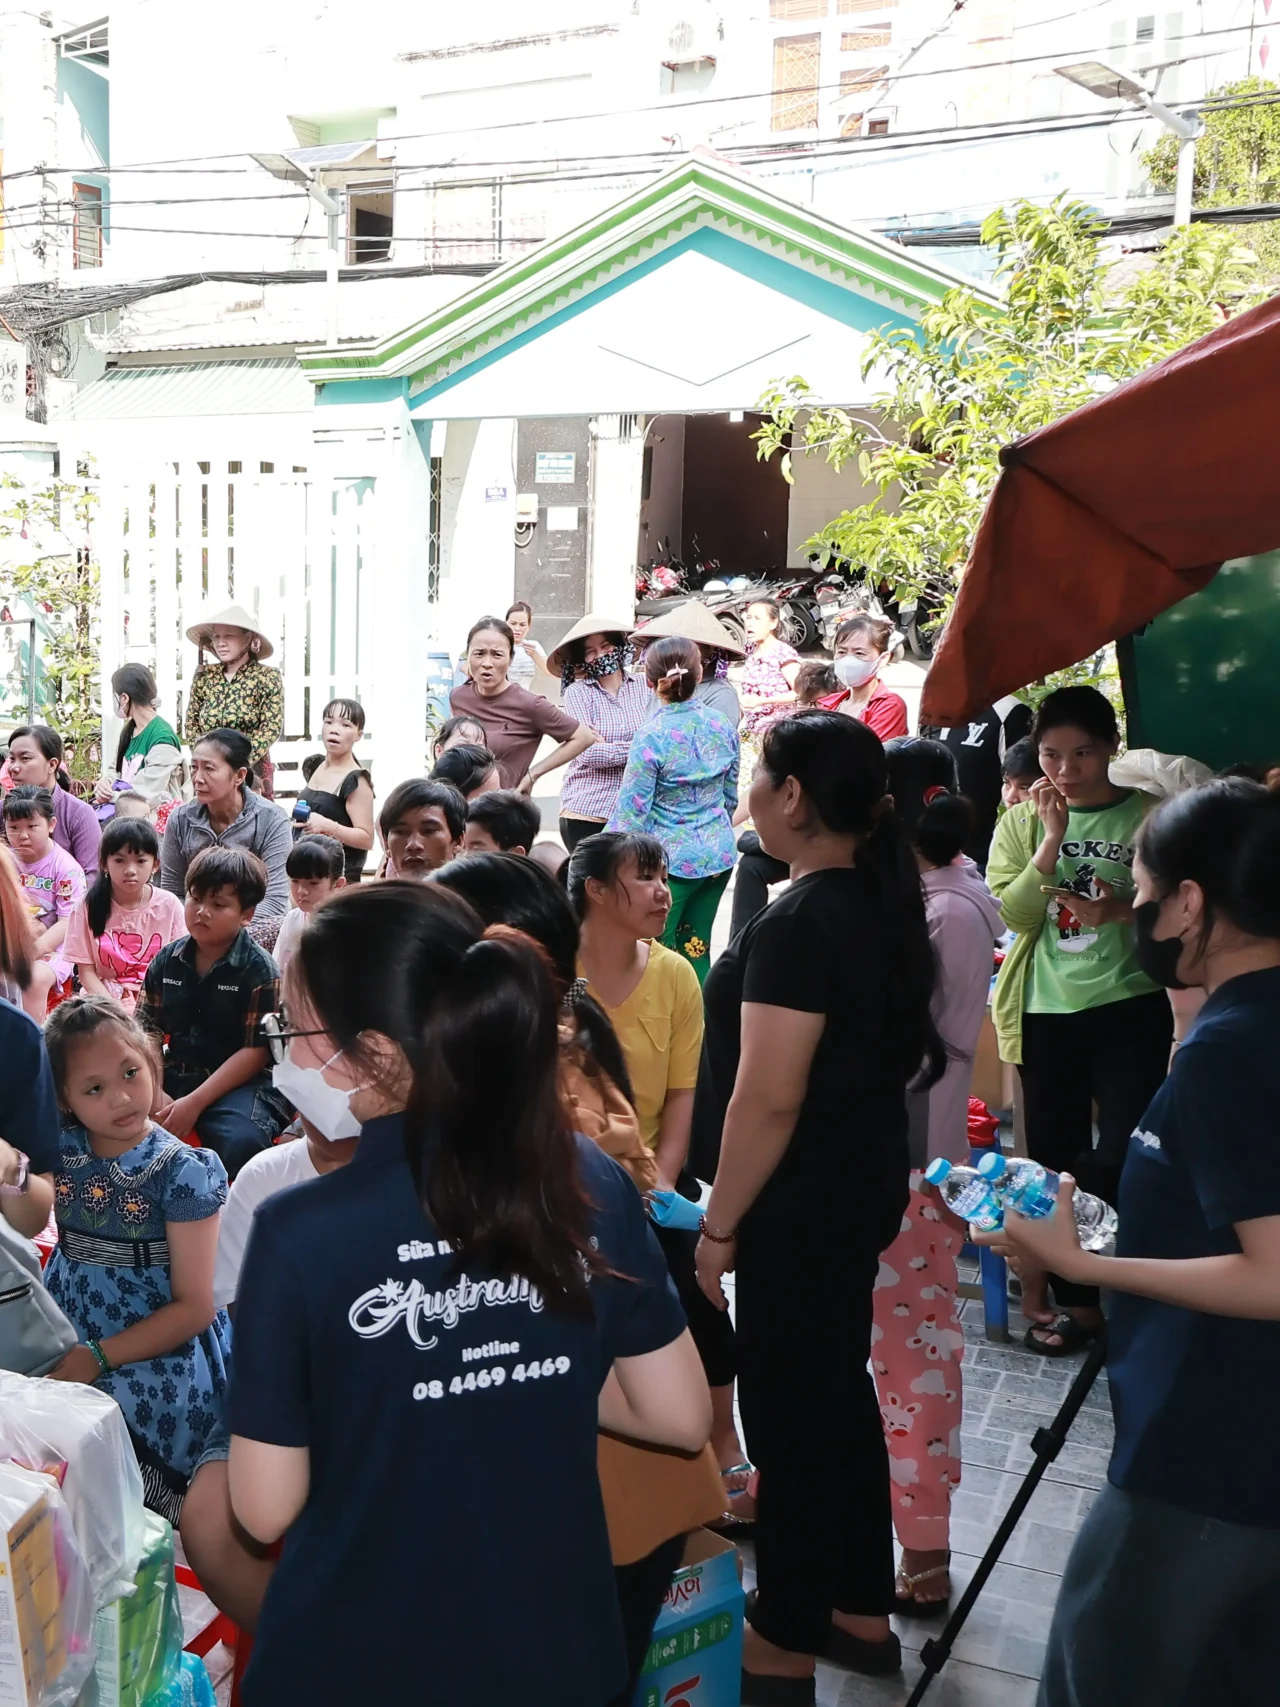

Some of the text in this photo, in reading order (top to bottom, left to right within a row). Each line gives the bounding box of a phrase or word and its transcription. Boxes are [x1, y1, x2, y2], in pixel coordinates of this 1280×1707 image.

[163, 977, 182, 986] ERSACE
[397, 1240, 435, 1262] Sữa
[462, 1340, 520, 1362] Hotline
[412, 1355, 570, 1400] 08 4469 4469
